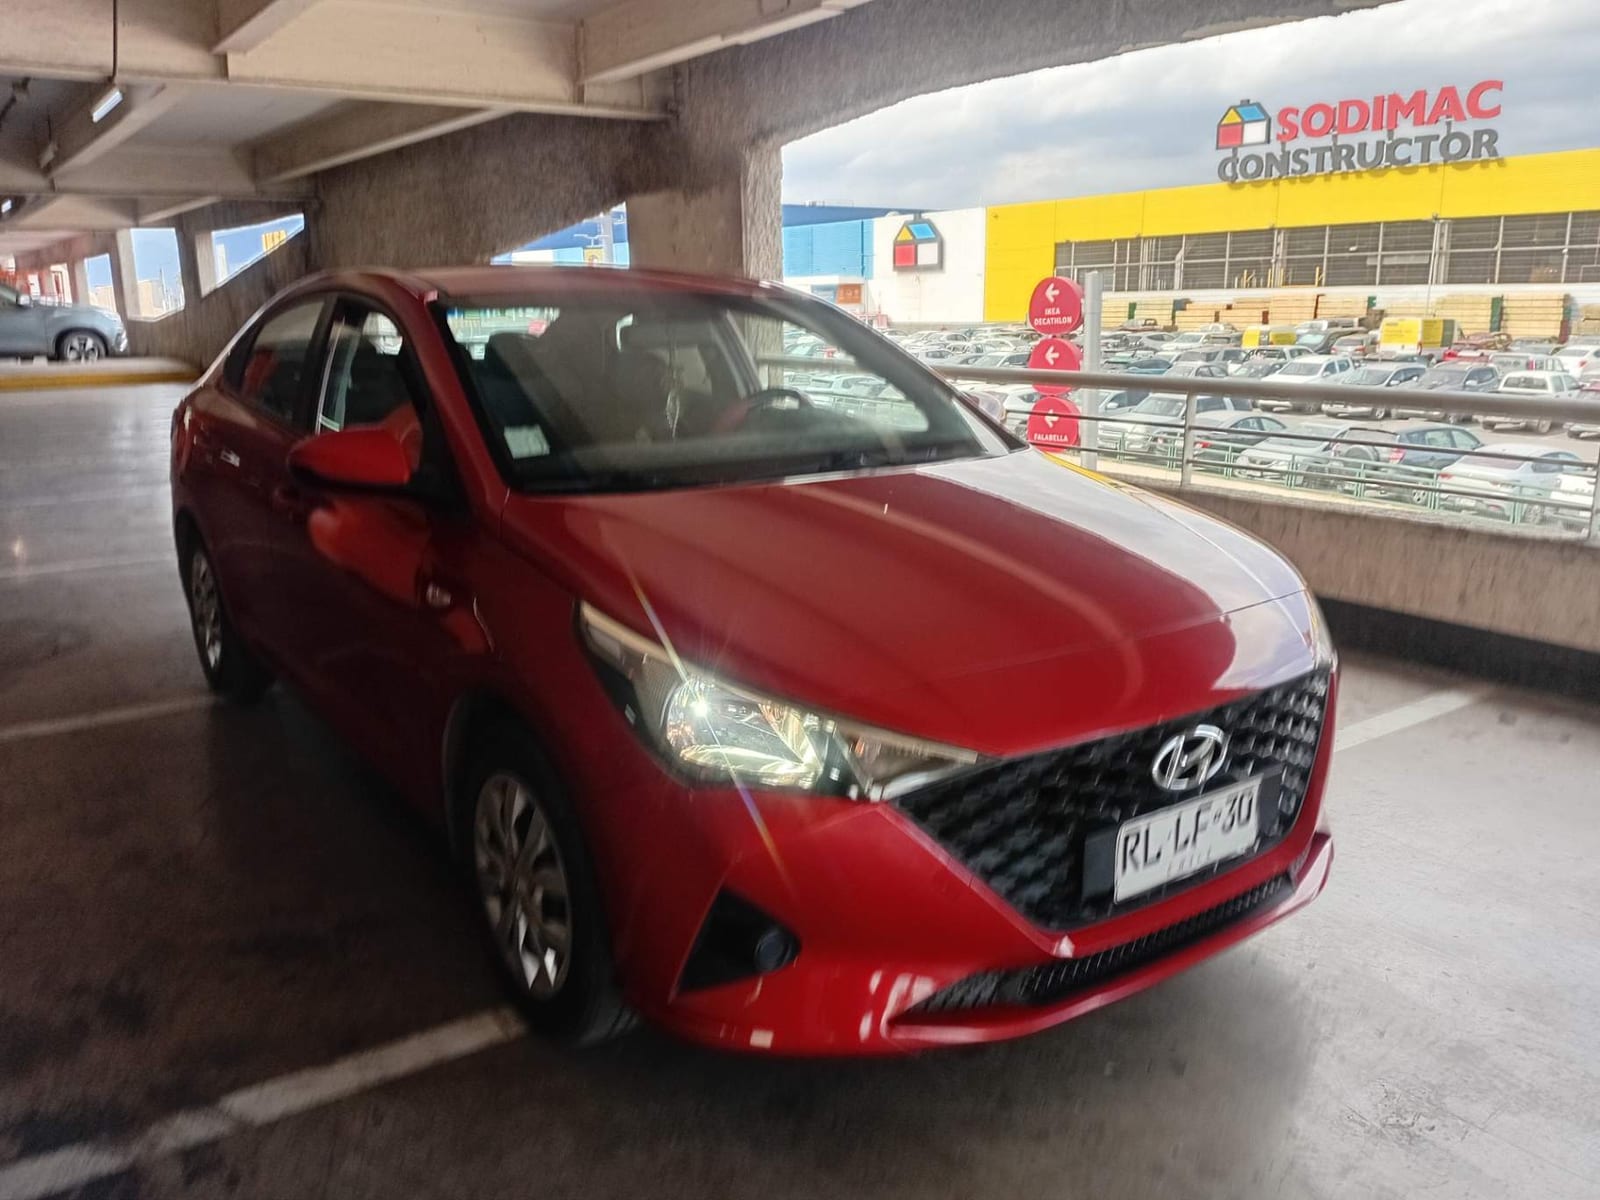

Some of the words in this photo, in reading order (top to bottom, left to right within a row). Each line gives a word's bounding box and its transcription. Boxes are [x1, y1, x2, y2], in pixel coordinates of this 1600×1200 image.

[1276, 80, 1504, 141] SODIMAC
[1217, 129, 1500, 182] CONSTRUCTOR
[1045, 307, 1061, 315] IKEA
[1034, 316, 1073, 326] DECATHLON
[1034, 432, 1069, 442] FALABELLA
